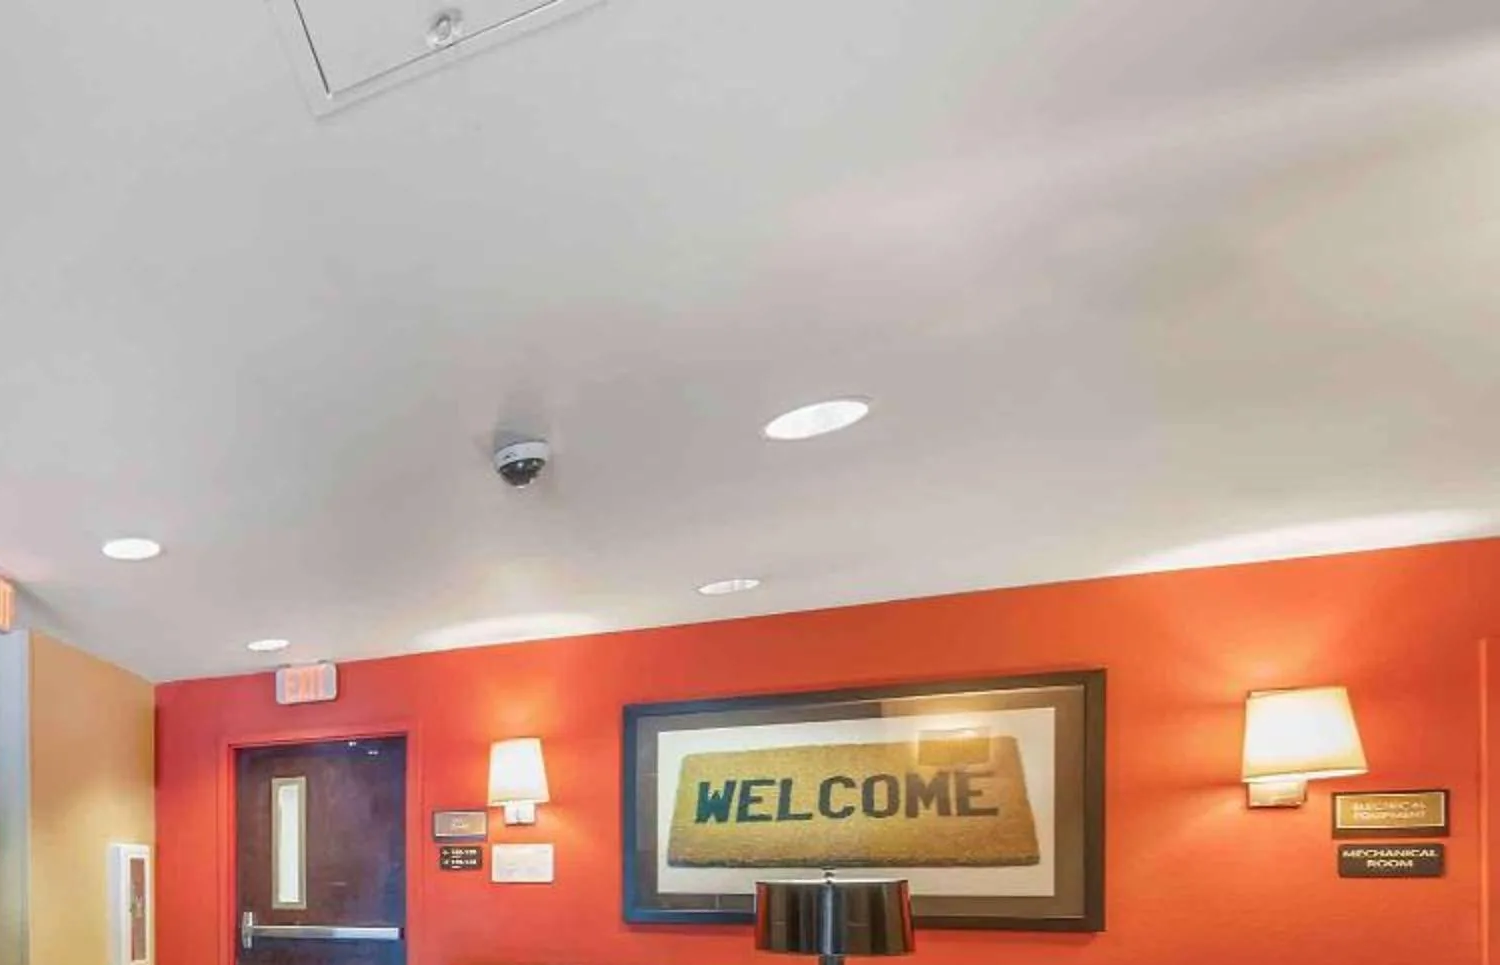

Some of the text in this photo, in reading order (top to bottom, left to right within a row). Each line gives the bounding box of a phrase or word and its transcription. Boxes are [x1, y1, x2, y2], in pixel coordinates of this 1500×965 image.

[694, 770, 999, 825] WELCOME
[1342, 849, 1438, 857] MECHANICAL
[1367, 859, 1413, 868] ROOM
